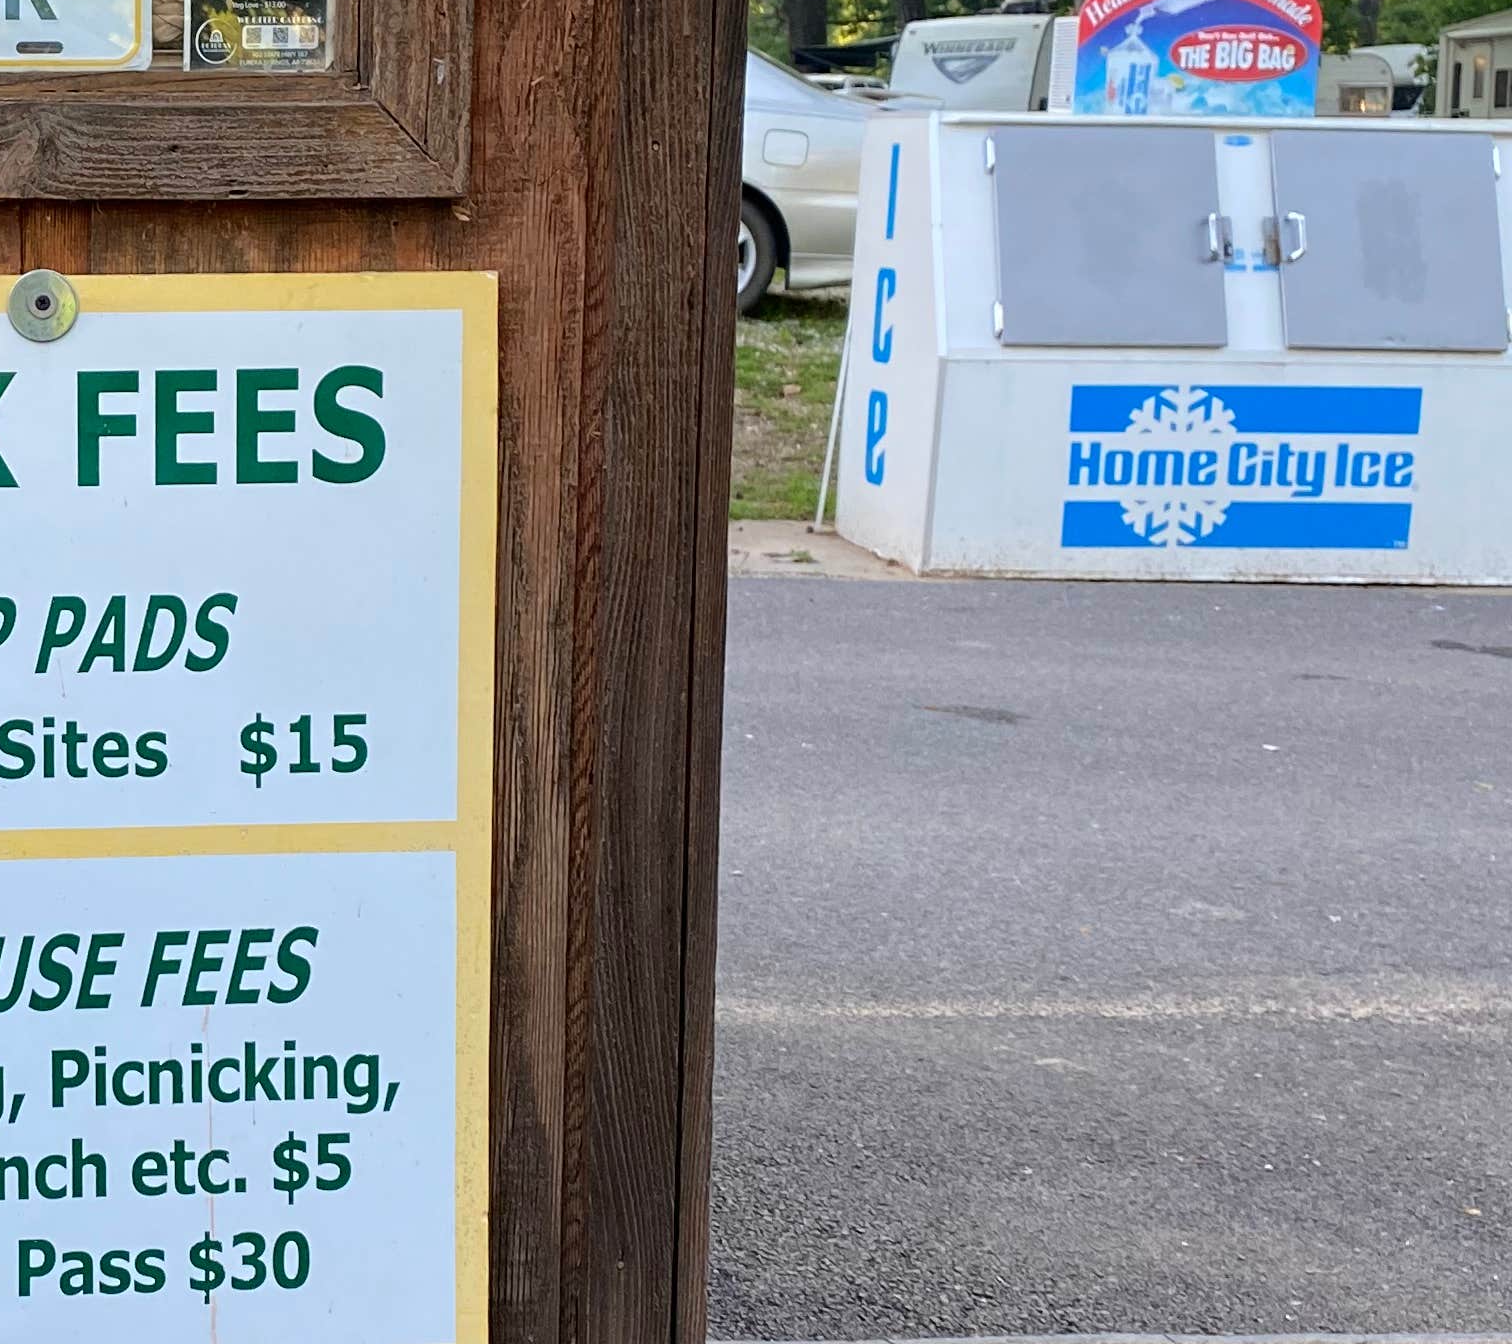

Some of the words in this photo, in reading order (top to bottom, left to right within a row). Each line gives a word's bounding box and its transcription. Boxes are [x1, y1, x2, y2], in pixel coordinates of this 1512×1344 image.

[1178, 44, 1211, 68] THE
[1215, 41, 1253, 70] BIG
[1257, 44, 1296, 71] BAG
[77, 365, 387, 488] FEES
[1068, 442, 1218, 486] Home
[1228, 442, 1326, 497] City
[1335, 444, 1414, 487] Ice
[36, 593, 239, 674] PADS
[239, 713, 370, 789] $15
[141, 926, 319, 1008] FEES
[50, 1041, 402, 1115] Picnicking,
[131, 1144, 249, 1197] etc.
[272, 1132, 353, 1207] $5
[17, 1240, 166, 1298] Pass
[188, 1230, 311, 1305] $30
